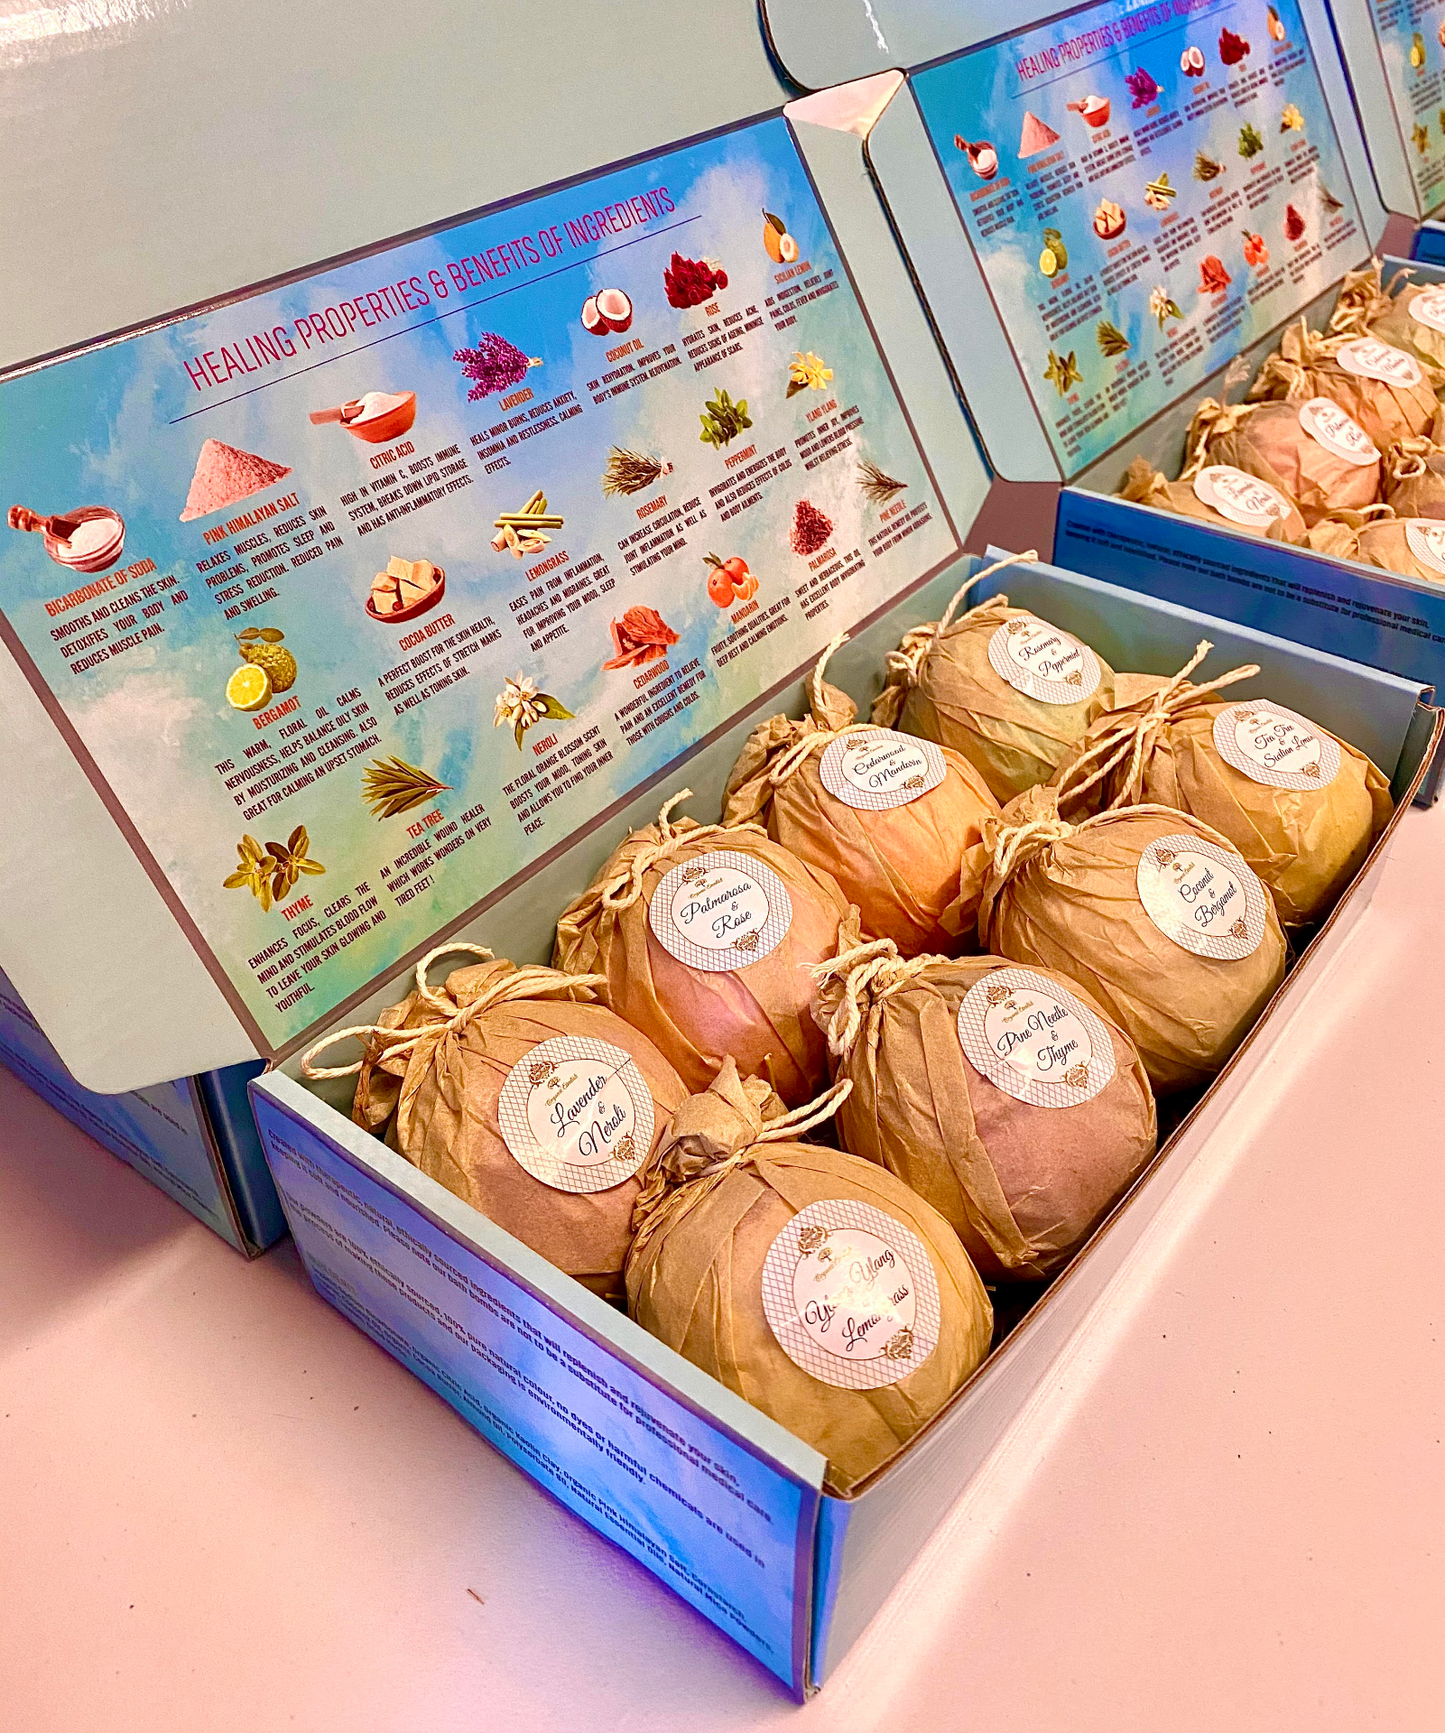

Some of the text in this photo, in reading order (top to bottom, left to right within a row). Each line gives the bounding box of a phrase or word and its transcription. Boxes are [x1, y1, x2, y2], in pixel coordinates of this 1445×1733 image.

[1016, 47, 1060, 82] HEALING
[1058, 25, 1115, 65] PROPERTIES
[1111, 21, 1122, 42] &
[182, 186, 675, 391] HEALING PROPERTIES & BENEFITS OF INGREDIENTS
[704, 301, 720, 316] ROSE
[605, 337, 644, 362] COCONUT OIL
[497, 387, 534, 411] LAVENDER
[805, 398, 837, 423] YLANG YLANG
[369, 440, 414, 469] CITRIC ACID
[724, 443, 757, 469] PEPPERMINT
[339, 443, 460, 506] HIGH IN VITAMIN C, BOOSTS IMMUNE
[202, 491, 299, 545] PINK HIMALAYAN SALT
[635, 494, 667, 519] ROSEMARY
[195, 505, 327, 573] RELAXES MUSCLES, REDUCES SKIN
[524, 550, 569, 581] LEMONGRASS
[807, 546, 837, 571] PALMAROSA
[44, 557, 157, 617] BICARBONATE OF SODA
[508, 552, 604, 612] EASES PAIN FROM INFLAMMATION,
[49, 574, 179, 641] SMOOTHS AND CLEANS THE SKIN.
[59, 589, 188, 658] DETOXIFIES YOUR BODY AND
[730, 599, 759, 624] MANDARIN
[69, 622, 164, 674] REDUCES MUSCLE PAIN.
[398, 613, 455, 651] COCOA BUTTER
[530, 623, 569, 652] AND APPETITE.
[1018, 636, 1061, 661] Rosemary
[632, 659, 669, 689] CEDARWOOD
[1038, 647, 1080, 677] Peppermint
[252, 695, 301, 730] BERGAMOT
[214, 687, 361, 774] THIS WARM, FLORAL OIL CALMS
[224, 701, 369, 790] NERVOUSNESS, HELPS BALANCE OILY SKIN
[532, 733, 558, 756] NEROLI
[1254, 733, 1275, 750] Tea
[1273, 724, 1294, 738] Tree
[1279, 737, 1286, 746] &
[509, 737, 607, 809] BOOSTS YOUR MOOD, TONING SKIN
[852, 745, 906, 775] Cedarwood
[868, 759, 922, 788] Mandarin
[1263, 746, 1294, 768] Sicilian
[405, 808, 444, 839] TEA TREE
[379, 803, 485, 879] AN INCREDIBLE WOUND HEALER
[1177, 867, 1215, 903] Coconut
[1208, 888, 1215, 898] &
[280, 894, 313, 921] THYME
[680, 882, 752, 924] Palmarosa
[731, 901, 739, 911] &
[1194, 881, 1237, 928] Bergamot
[247, 881, 370, 969] ENHANCES FOCUS, CLEARS THE
[256, 895, 377, 984] MIND AND STIMULATES BLOOD FLOW
[711, 911, 752, 939] Rose
[997, 1028, 1032, 1057] Pine
[1027, 1005, 1069, 1031] Needle
[1050, 1030, 1059, 1041] &
[1037, 1039, 1079, 1071] Thyme
[550, 1074, 607, 1138] Lavender
[597, 1101, 605, 1114] &
[578, 1104, 627, 1156] Neroli
[469, 1279, 739, 1486] ingredients that will replenish and rejuvenate your skin,
[488, 1348, 703, 1519] natural colour, no dyes or harmful chemicals
[517, 1379, 645, 1484] is environmentally friendly.
[567, 1364, 744, 1501] substitute for professional medical
